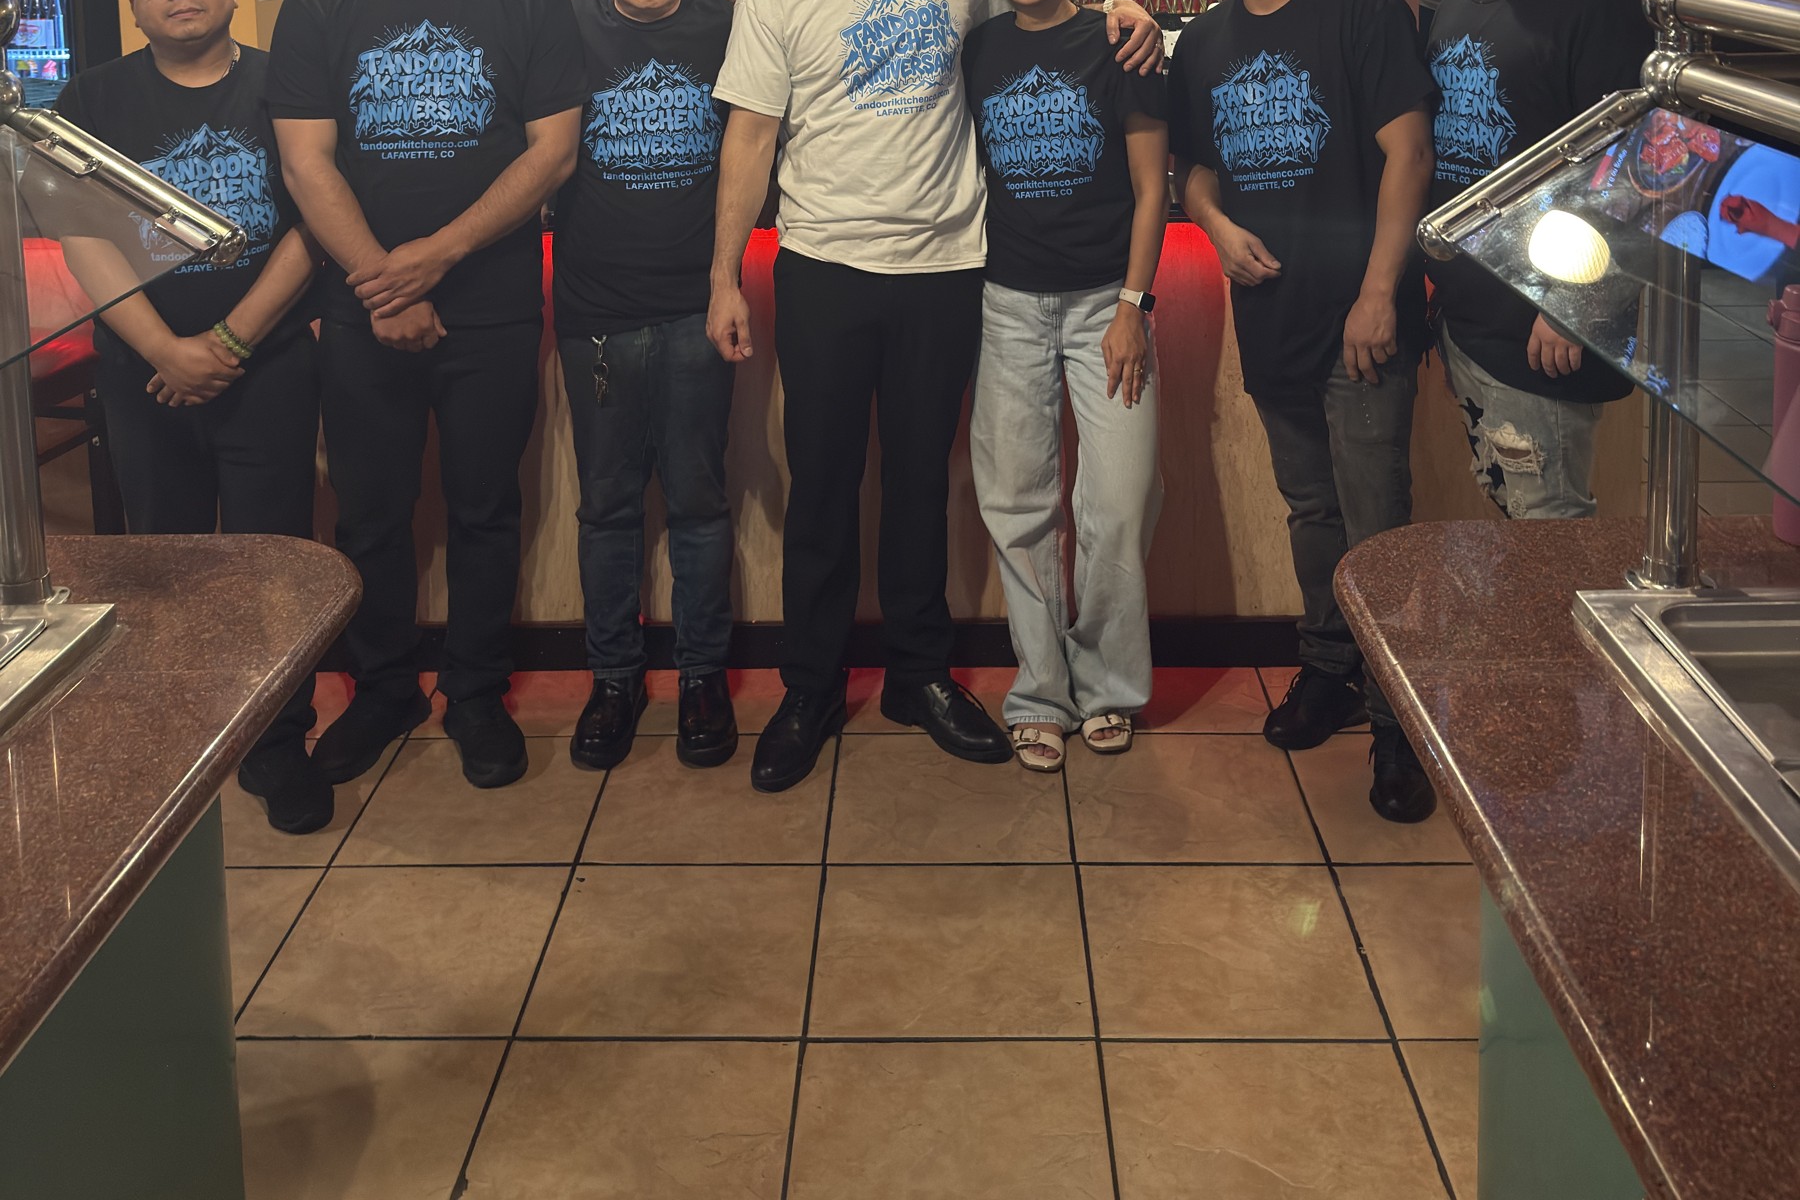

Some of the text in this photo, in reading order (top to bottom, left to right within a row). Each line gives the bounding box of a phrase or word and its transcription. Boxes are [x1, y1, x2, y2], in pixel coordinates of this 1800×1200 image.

[840, 0, 950, 50] TANDOORi
[860, 26, 948, 69] KiTCHEN
[358, 47, 483, 82] TANDOORi
[372, 72, 472, 102] KiTCHEN
[592, 82, 712, 117] TANDOORi
[1211, 70, 1310, 108] TANDOORi
[355, 98, 491, 136] ANNiVERSARY
[926, 102, 937, 110] CO
[982, 86, 1088, 119] TANDOORi
[1226, 97, 1304, 133] KiTCHEN
[608, 108, 704, 137] KiTCHEN
[992, 112, 1081, 142] KiTCHEN
[360, 139, 478, 151] tandoorikitchenco.com
[382, 150, 455, 160] LAFAYETTE, CO
[592, 132, 717, 164] ANNiVERSARY
[1220, 122, 1322, 167] ANNiVERSARY
[141, 148, 268, 185] TANDOORi
[603, 164, 712, 181] tandoorikitchenco.com
[1459, 174, 1470, 184] CO
[626, 178, 693, 190] LAFAYETTE, CO
[1015, 188, 1073, 199] AFAYETTE, CO
[1240, 179, 1295, 191] LAFAYETTE, CO
[236, 259, 250, 268] CO
